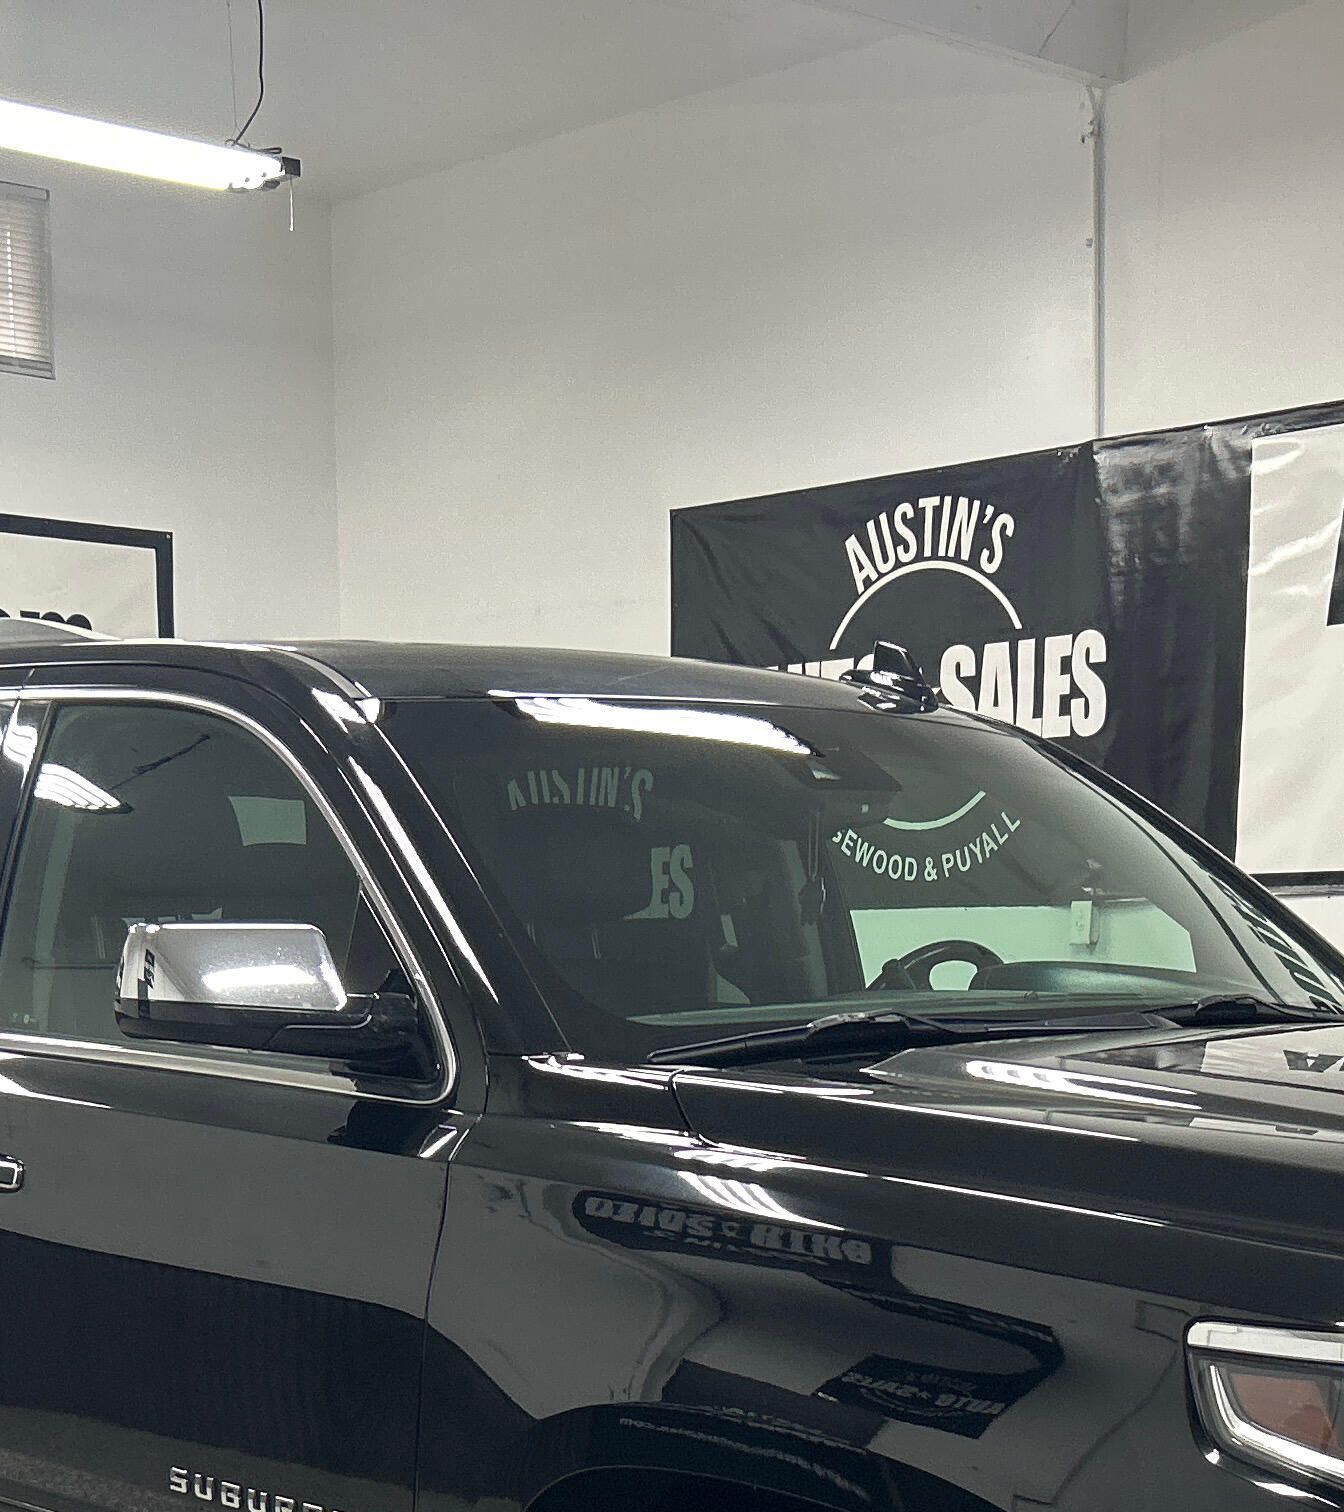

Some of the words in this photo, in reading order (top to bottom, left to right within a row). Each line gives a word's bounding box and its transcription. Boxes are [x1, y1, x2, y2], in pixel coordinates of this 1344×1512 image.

[844, 495, 1015, 595] AUSTIN'S
[940, 629, 1107, 738] SALES
[924, 857, 938, 882] &
